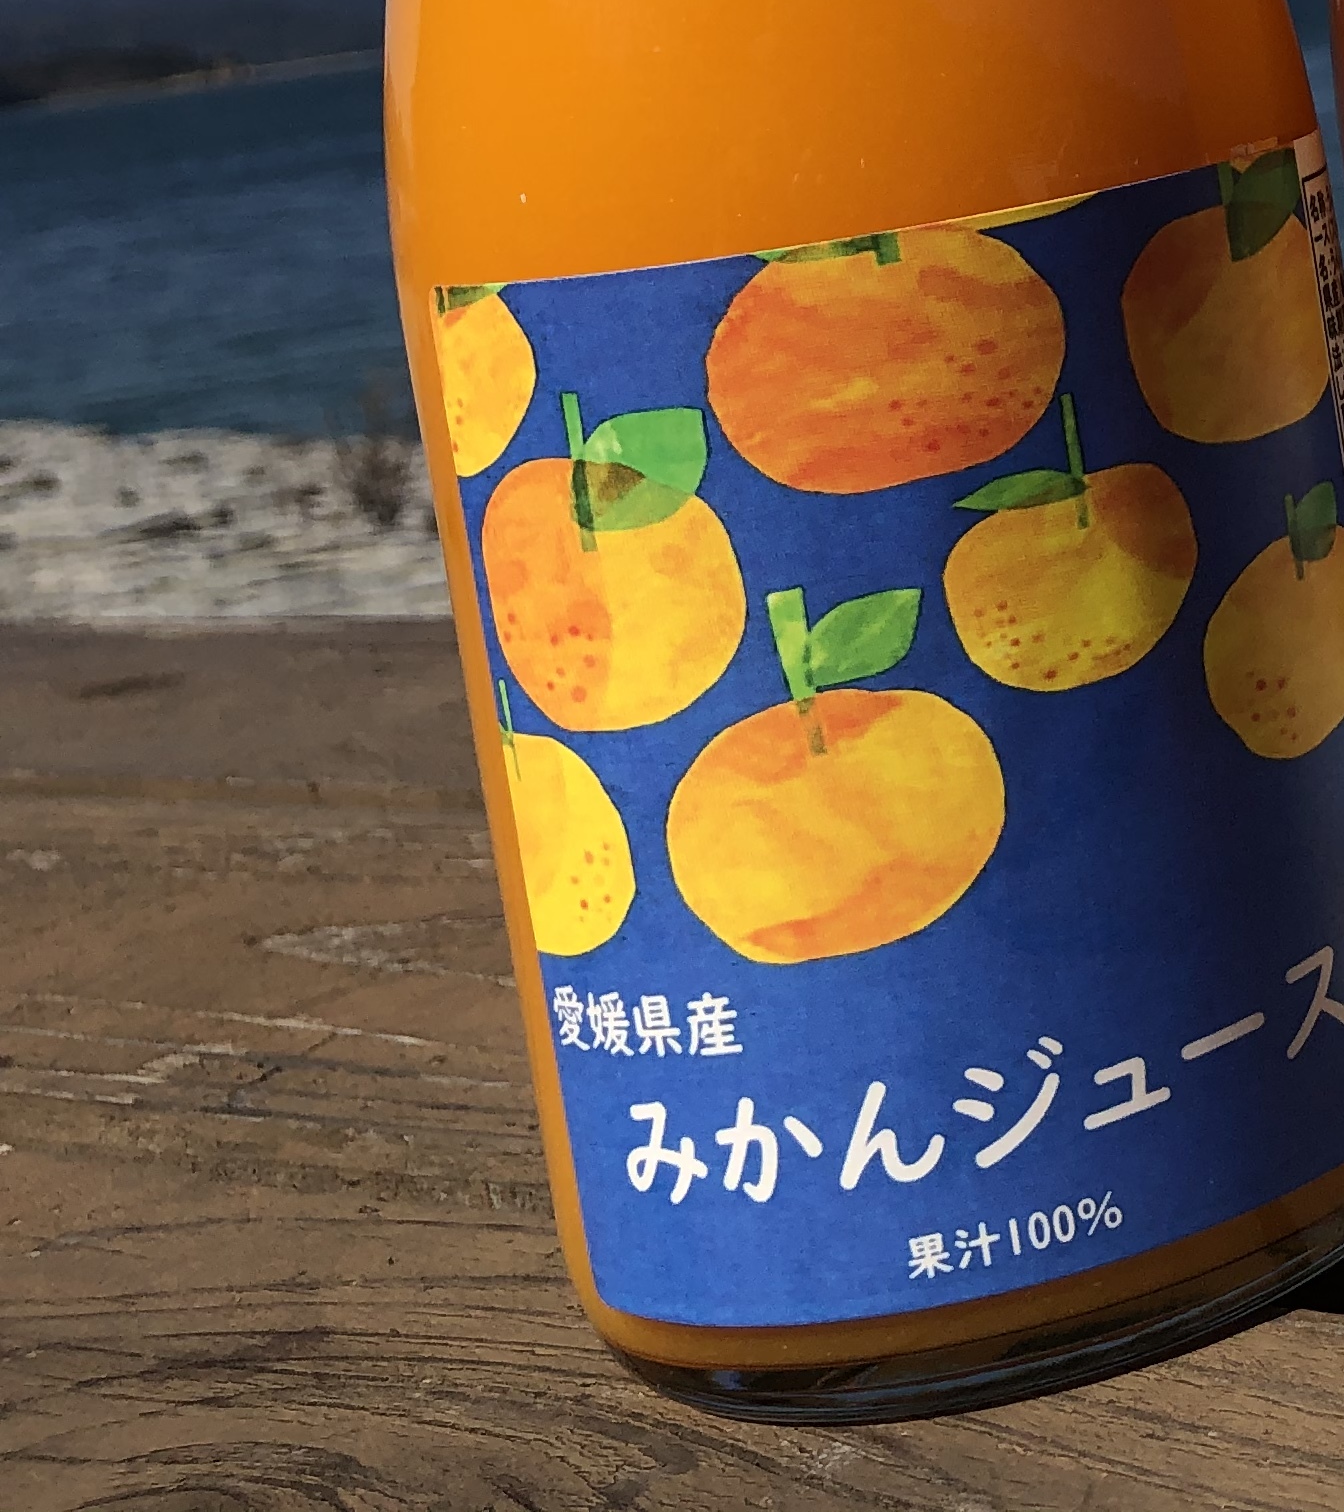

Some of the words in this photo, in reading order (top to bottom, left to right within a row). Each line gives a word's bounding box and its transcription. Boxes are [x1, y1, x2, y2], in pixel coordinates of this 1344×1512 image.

[553, 985, 744, 1057] 愛媛県産
[906, 1191, 1124, 1281] 果汁100%
